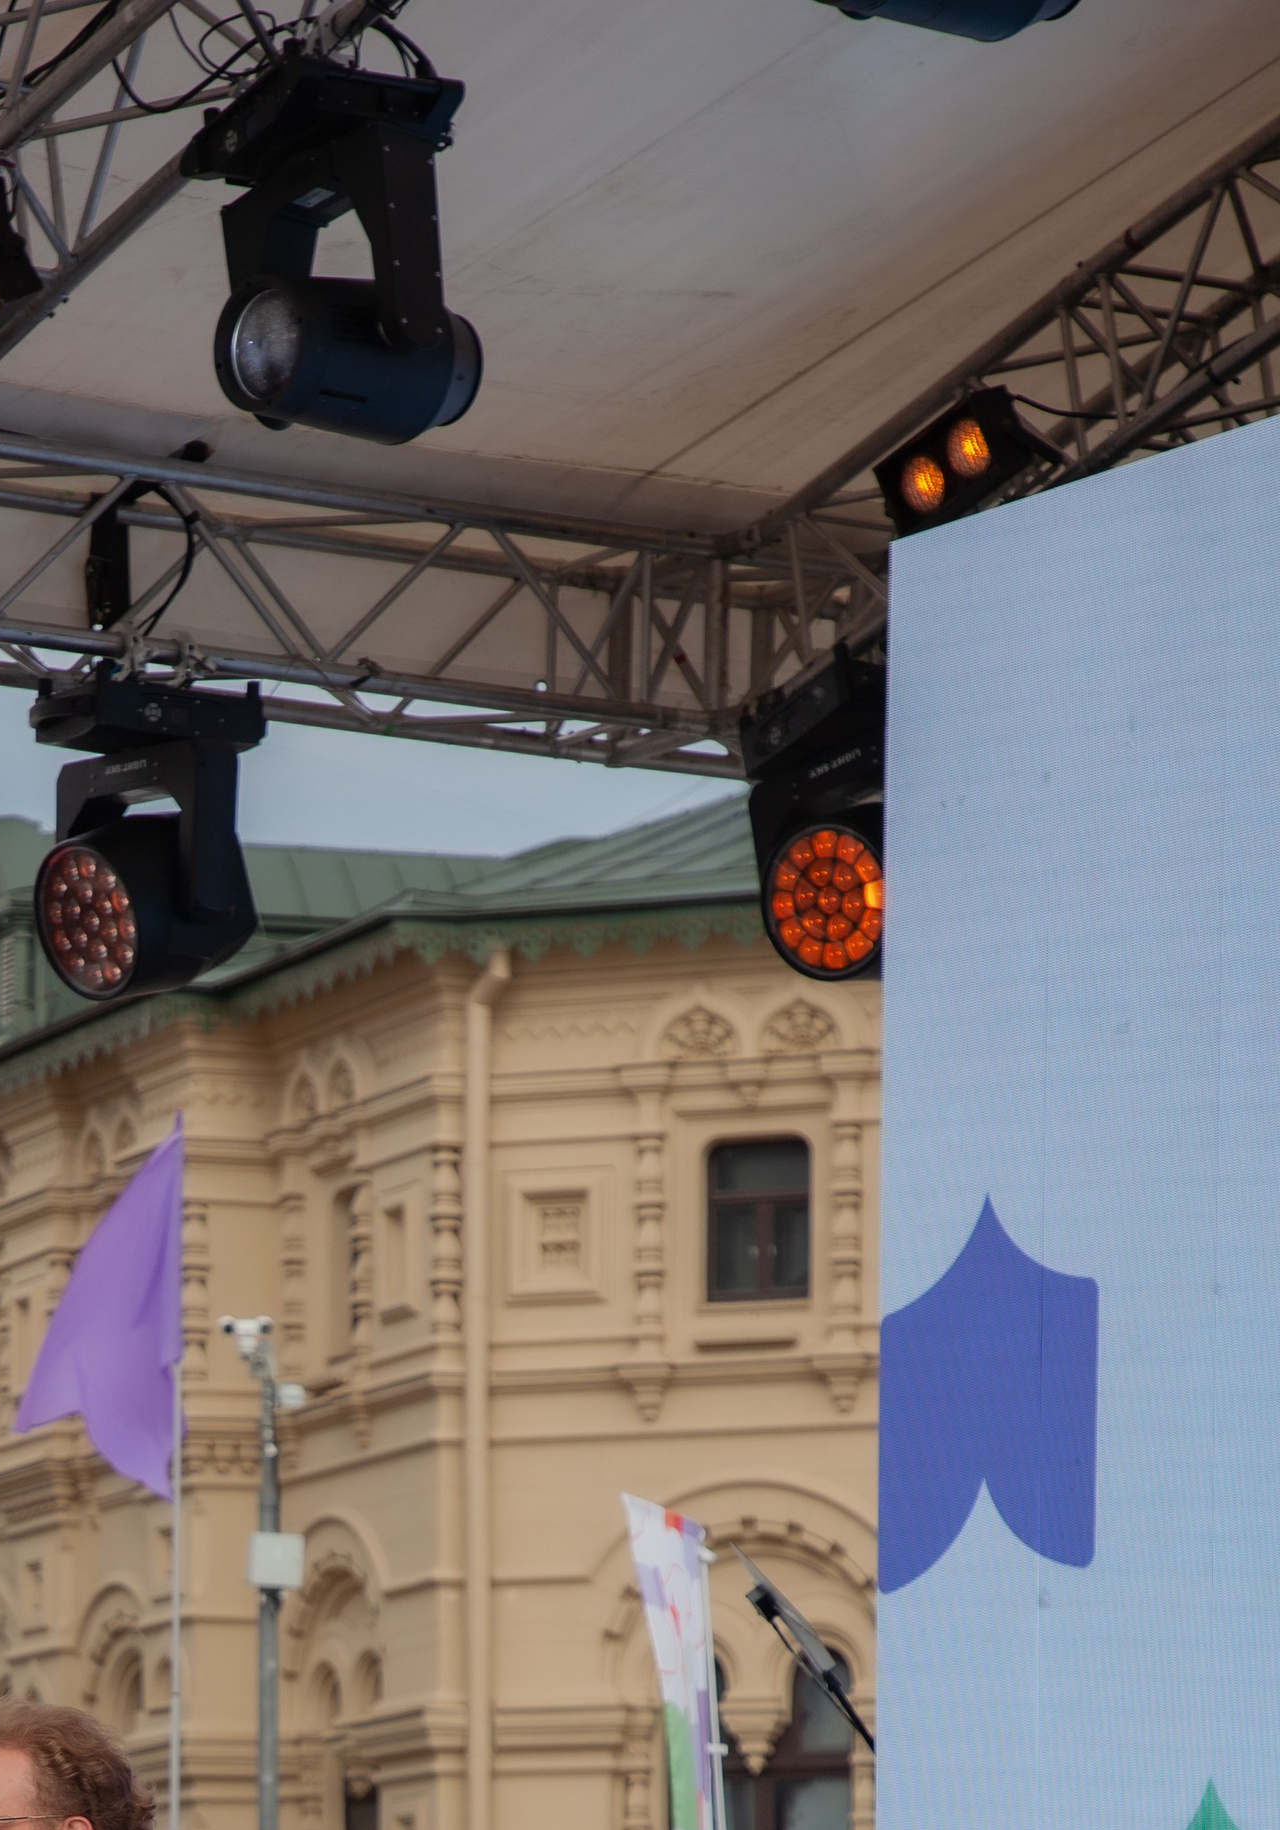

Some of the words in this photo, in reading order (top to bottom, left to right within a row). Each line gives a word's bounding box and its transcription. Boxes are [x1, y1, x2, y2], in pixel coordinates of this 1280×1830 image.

[122, 759, 147, 772] LIGHT
[831, 748, 862, 769] LIGHT
[807, 763, 831, 779] SKY
